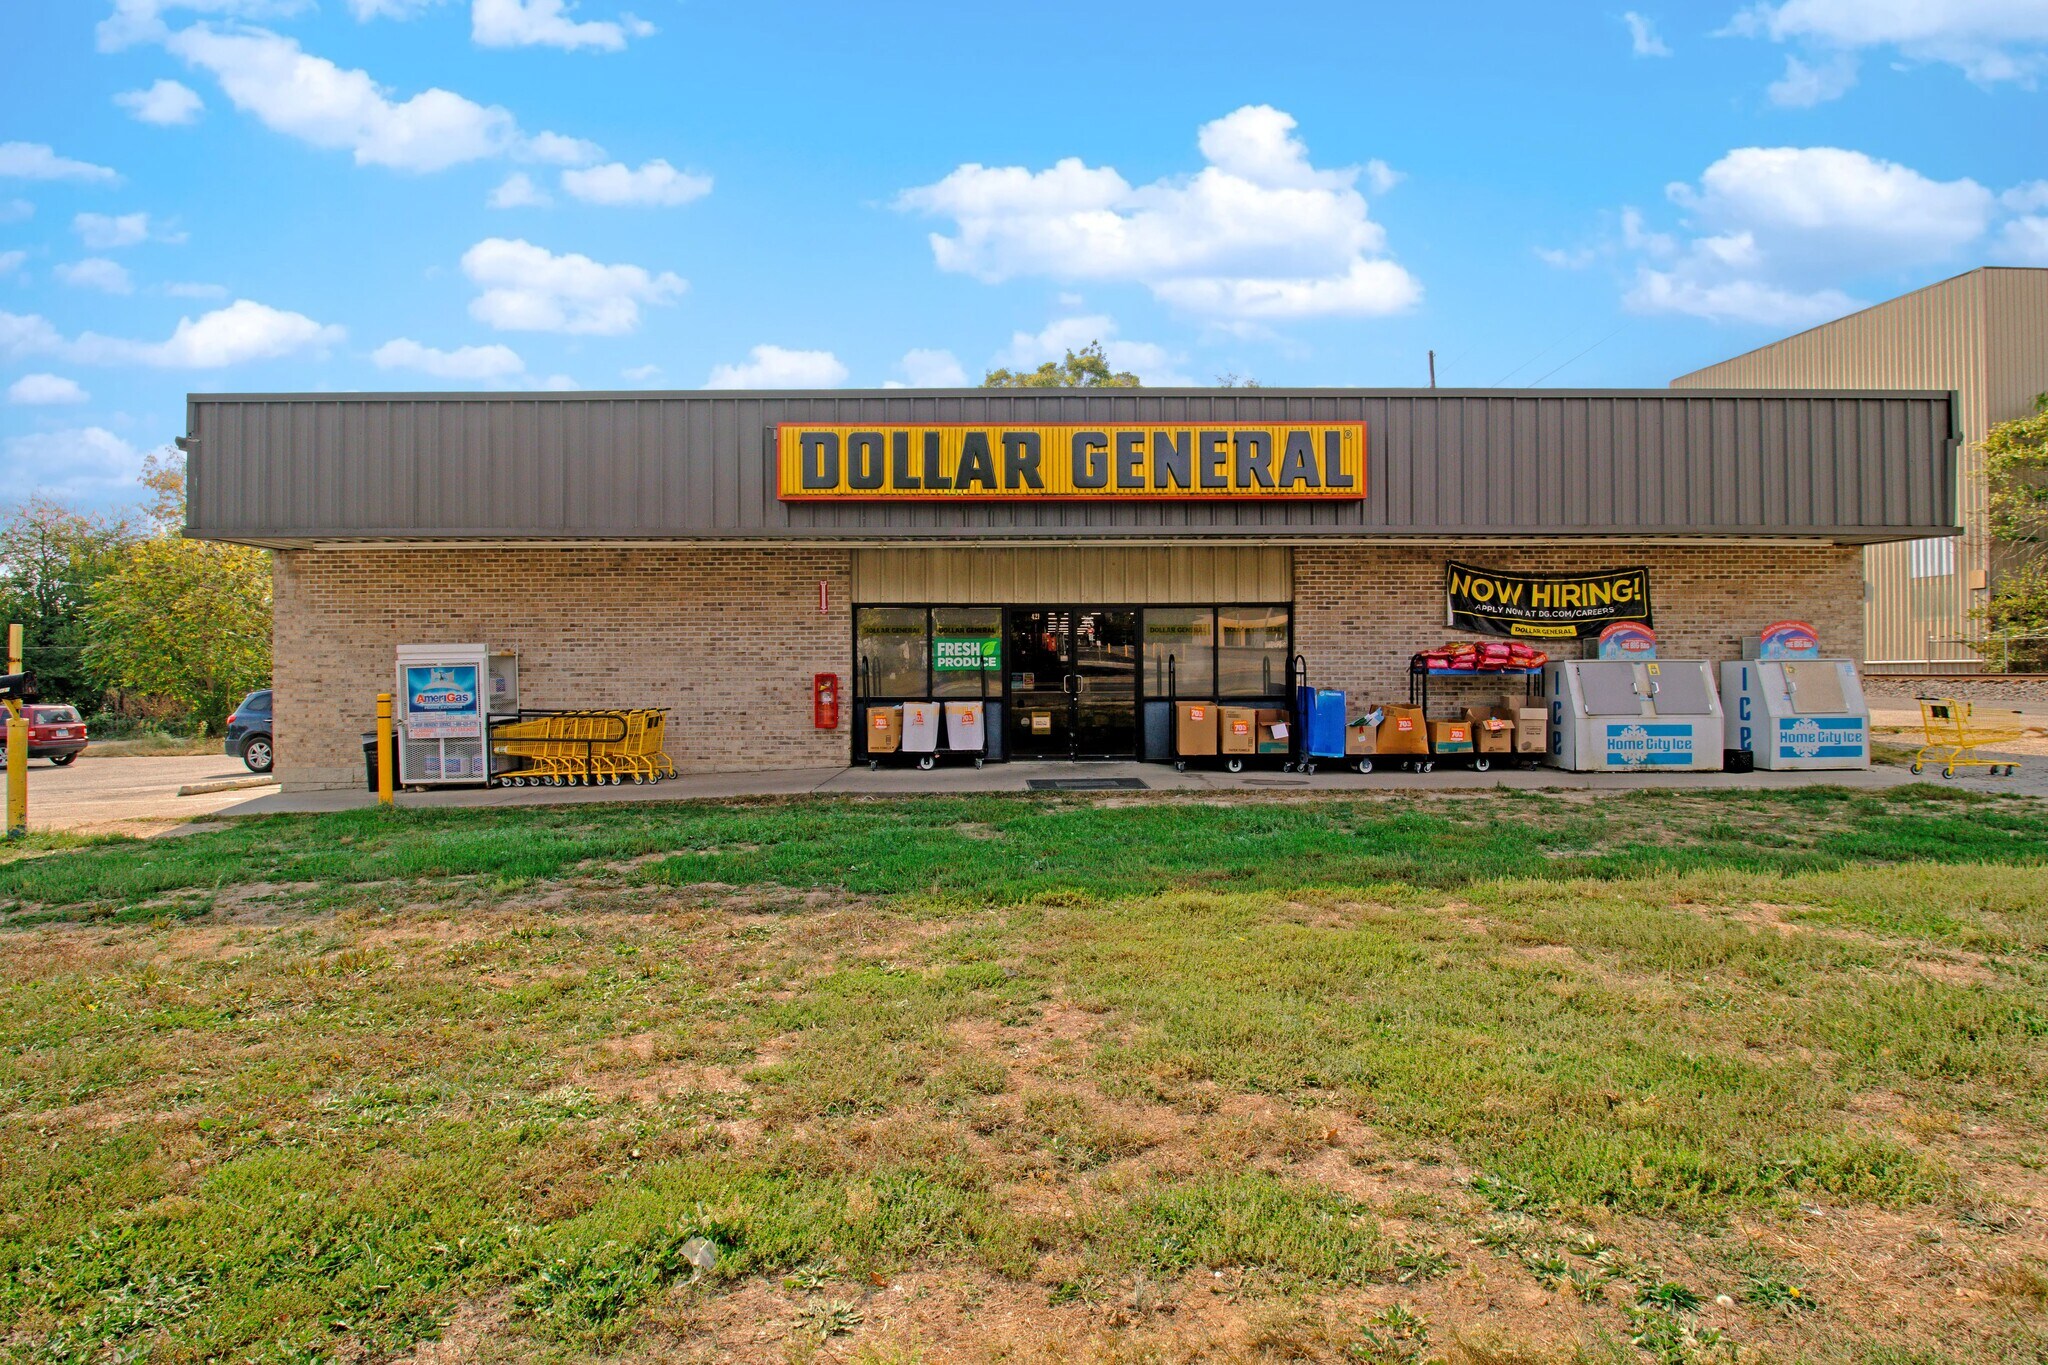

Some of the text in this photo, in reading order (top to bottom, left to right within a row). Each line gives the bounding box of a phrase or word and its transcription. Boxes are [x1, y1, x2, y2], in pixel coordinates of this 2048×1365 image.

[801, 431, 1353, 489] DOLLAR GENERAL
[1451, 572, 1641, 607] NOW HIRING!
[1475, 604, 1615, 618] APPLY NOW AT DG.COM/CAREERS
[1514, 626, 1541, 635] DOLLAR
[937, 642, 980, 656] FRESH
[937, 657, 997, 667] PRODUCE
[416, 693, 468, 703] AmeriGas
[1607, 738, 1692, 752] Home City Ice
[1780, 731, 1862, 745] Home City Ice
